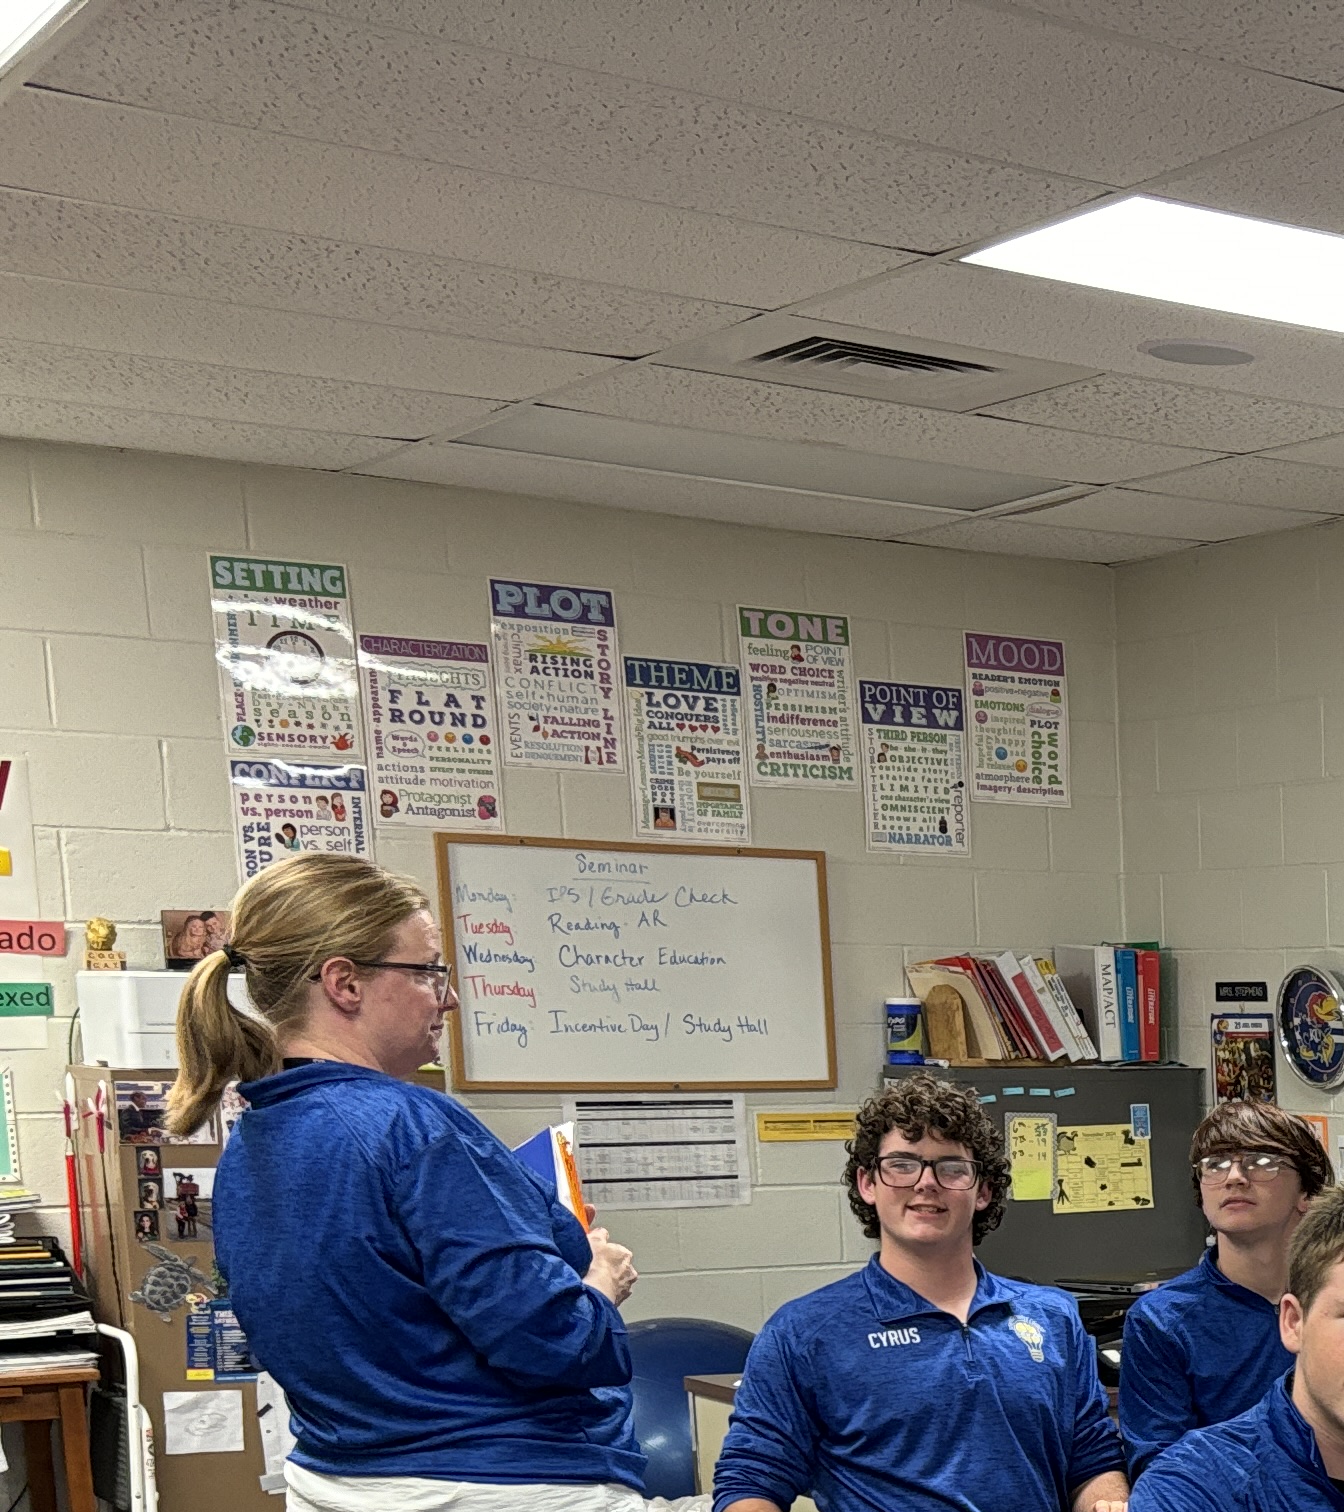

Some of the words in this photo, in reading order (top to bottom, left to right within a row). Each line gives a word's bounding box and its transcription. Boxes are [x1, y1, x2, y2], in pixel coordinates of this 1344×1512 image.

[215, 560, 343, 594] SETTING
[274, 596, 340, 610] weather
[494, 583, 610, 624] PLOT
[501, 622, 569, 636] exposition
[743, 610, 846, 643] TONE
[362, 637, 486, 661] CHARACTERIZATION
[747, 643, 790, 661] feeling
[805, 644, 843, 656] POINT
[969, 638, 1061, 671] MOOD
[529, 653, 593, 668] RISING
[806, 655, 820, 665] OF
[821, 656, 845, 667] VIEW
[530, 665, 594, 680] ACTION
[627, 659, 738, 692] THEME
[749, 663, 786, 675] WORD
[791, 665, 834, 679] CHOICE
[505, 677, 598, 694] CONFLICT
[972, 673, 1015, 684] READER'S
[1018, 677, 1060, 687] EMOTION
[388, 689, 486, 710] FLAT
[777, 688, 837, 700] OPTIMISM
[864, 683, 928, 706] POINT
[932, 690, 959, 709] OF
[645, 691, 719, 713] LOVE
[766, 703, 838, 715] PESSIMISM
[974, 699, 1025, 713] EMOTIONS
[254, 708, 351, 722] season
[388, 707, 487, 729] ROUND
[559, 705, 599, 716] nature
[646, 709, 720, 724] CONQUERS
[752, 684, 767, 744] HOSTILITY
[864, 703, 959, 728] VIEW
[543, 715, 600, 729] FALLING
[647, 721, 675, 732] ALL
[767, 712, 838, 728] indifference
[1030, 719, 1060, 730] PLOT
[258, 731, 329, 745] SENSORY
[508, 712, 522, 759] EVENTS
[550, 728, 601, 741] ACTION
[767, 726, 839, 740] seriousness
[876, 728, 908, 742] THIRD
[910, 731, 947, 744] PERSON
[524, 740, 583, 753] RESOLUTION
[769, 750, 830, 762] enthusiasm
[889, 755, 948, 767] OBJECTIVE
[1031, 730, 1046, 785] choice
[1048, 732, 1063, 786] word
[377, 763, 425, 774] actions
[694, 769, 742, 781] yourself
[756, 761, 854, 781] CRITICISM
[377, 775, 426, 787] attitude
[430, 778, 494, 790] motivation
[975, 772, 1030, 785] atmosphere
[880, 783, 950, 796] LIMITED
[240, 792, 313, 805] person
[399, 788, 473, 807] Protagonist
[241, 807, 262, 817] vs.
[264, 807, 314, 819] person
[405, 803, 477, 819] Antagonist
[881, 803, 950, 815] OMNISCIENT
[352, 796, 365, 854] INTERNAL
[951, 790, 966, 848] reporter
[300, 824, 350, 838] person
[301, 839, 321, 851] vs.
[326, 838, 352, 851] self
[888, 832, 954, 847] NARRATOR
[576, 853, 648, 875] Seminar
[675, 884, 739, 908] Check
[637, 910, 668, 929] AR
[558, 944, 645, 968] Character
[658, 946, 727, 966] Education
[464, 975, 537, 1009] Thursday
[570, 975, 620, 1002] Study
[1100, 964, 1117, 1029] MAP/ACT
[548, 1010, 627, 1034] Incentive
[628, 1012, 660, 1042] Day
[682, 1012, 733, 1043] Study
[736, 1016, 769, 1037] Hall
[867, 1327, 922, 1350] CYRUS
